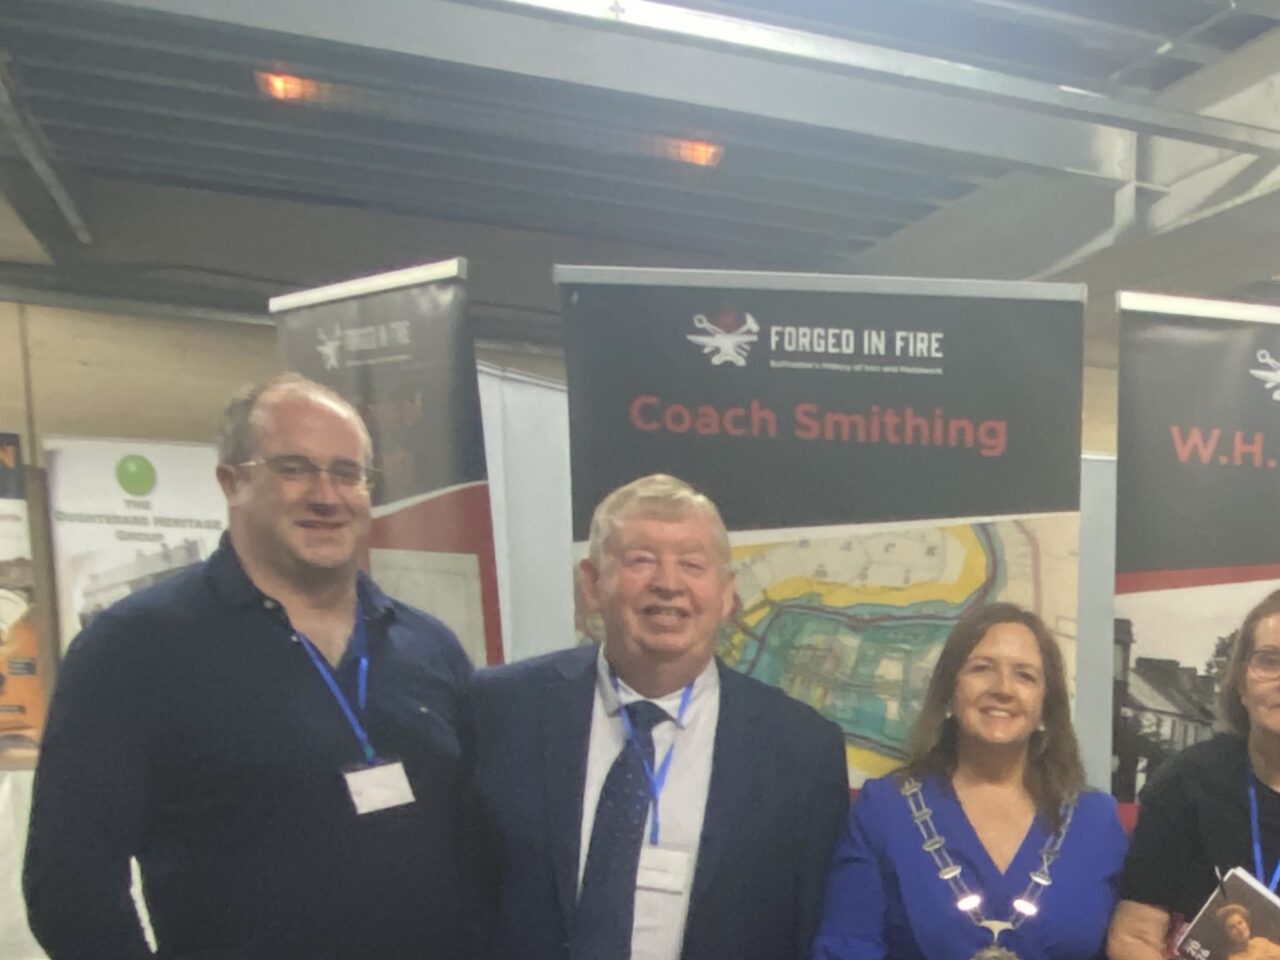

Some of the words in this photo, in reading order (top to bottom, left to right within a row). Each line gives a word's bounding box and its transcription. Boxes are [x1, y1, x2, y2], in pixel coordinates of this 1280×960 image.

[770, 326, 854, 355] FORGED
[863, 329, 886, 356] IN
[895, 331, 944, 358] FIRE
[629, 394, 777, 439] Coach
[793, 402, 1008, 457] Smithing
[1170, 425, 1277, 469] W.H.
